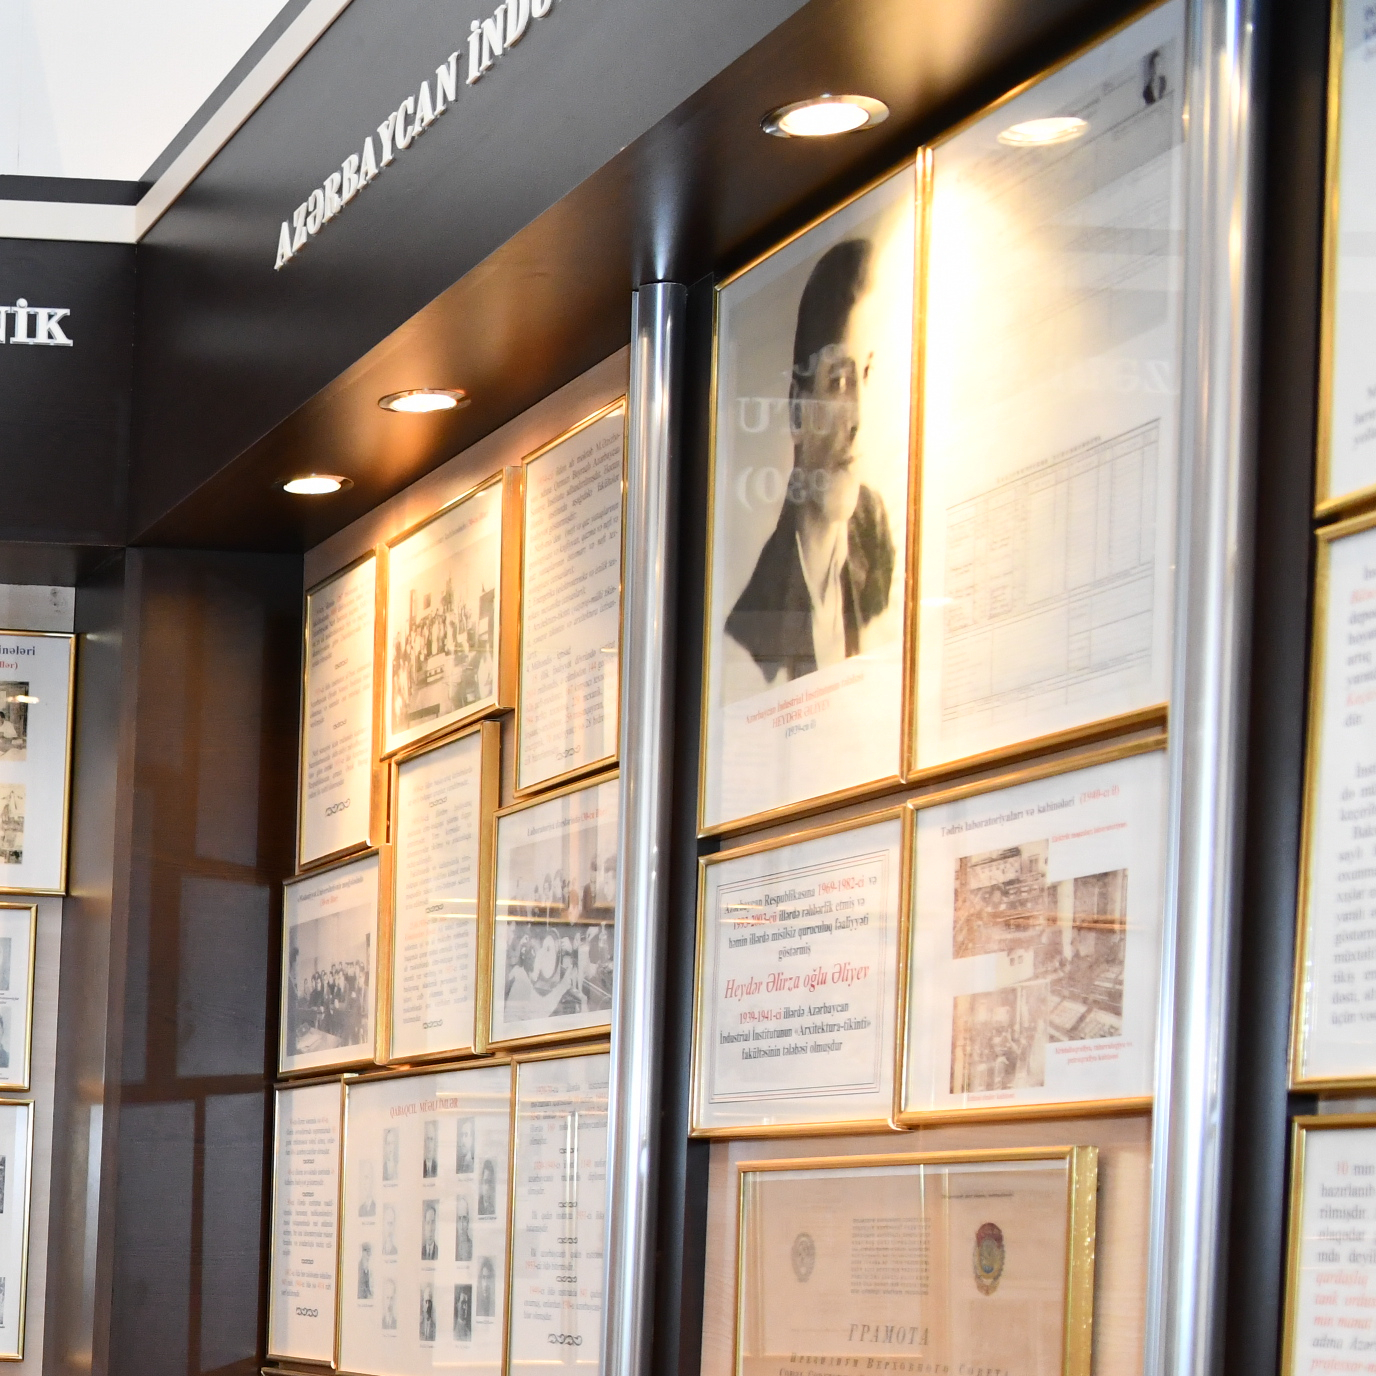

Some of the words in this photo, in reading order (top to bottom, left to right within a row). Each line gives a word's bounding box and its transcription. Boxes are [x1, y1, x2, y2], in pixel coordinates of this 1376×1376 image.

[274, 50, 460, 270] AZƏRBAYCAN
[724, 976, 763, 999] Heydər
[766, 972, 800, 993] Əlirza
[803, 966, 828, 993] oğlu
[831, 963, 869, 987] Əliyev
[847, 1323, 930, 1346] ГРАМОТА
